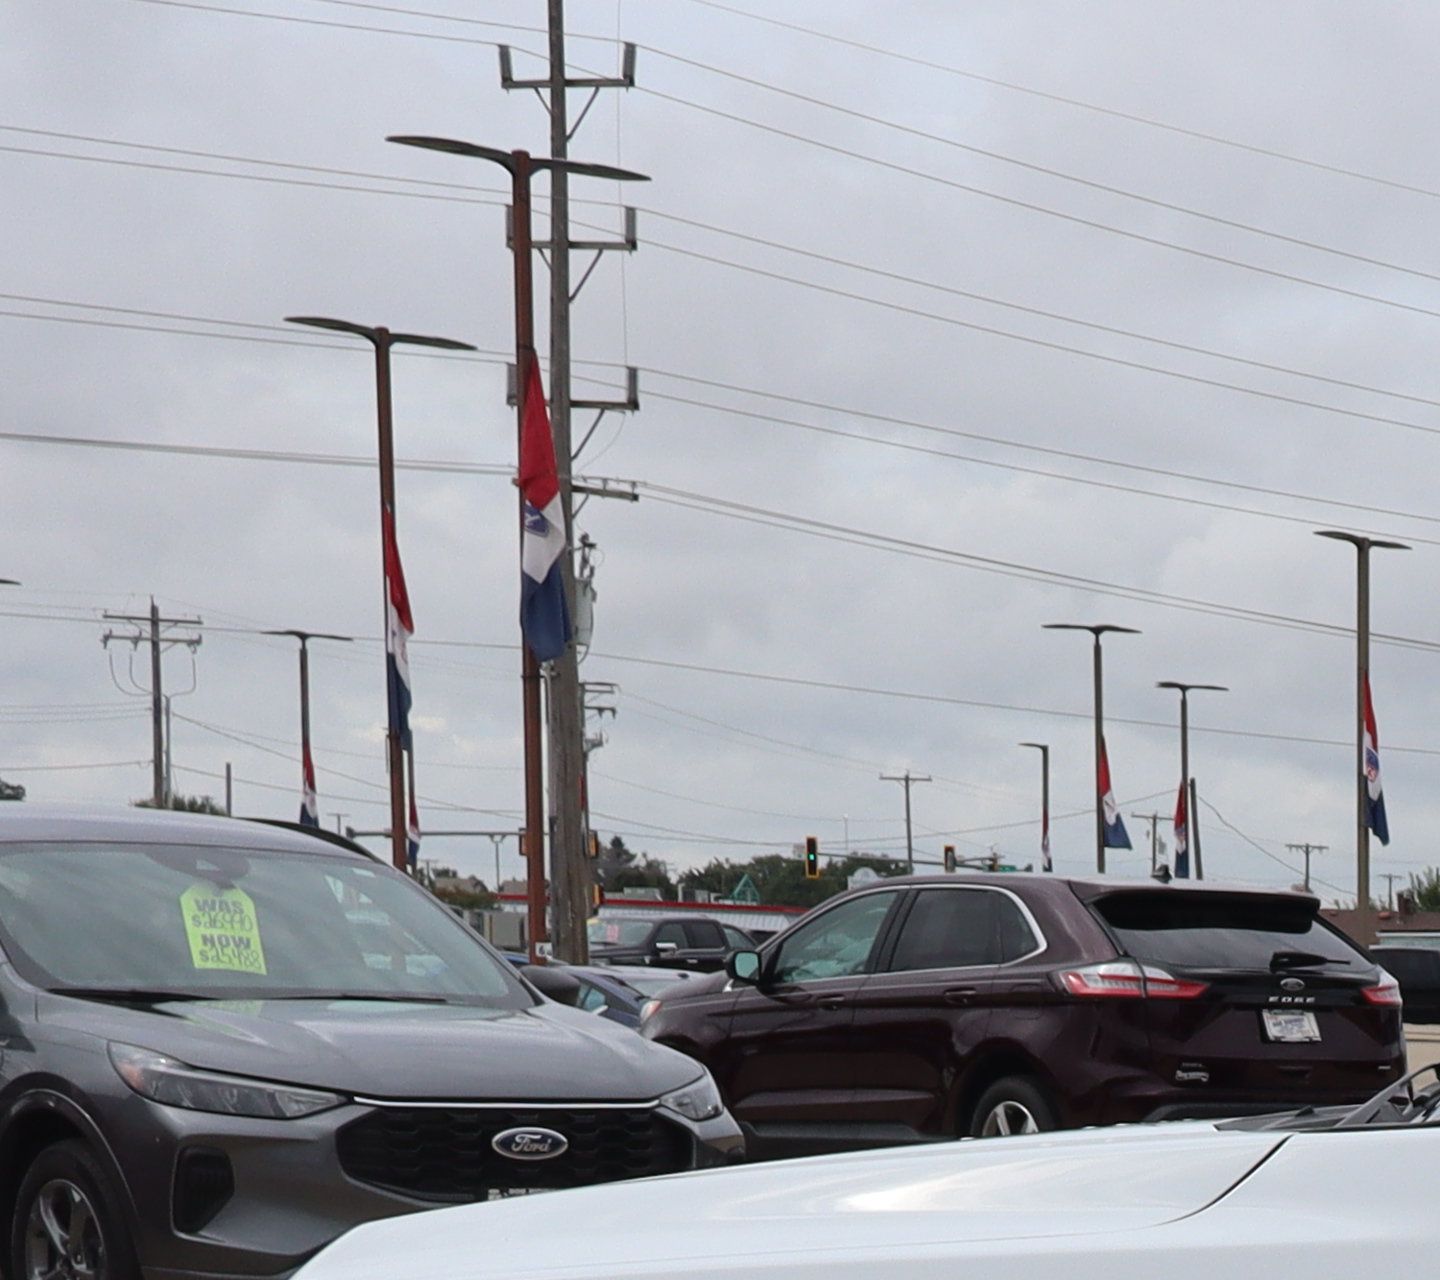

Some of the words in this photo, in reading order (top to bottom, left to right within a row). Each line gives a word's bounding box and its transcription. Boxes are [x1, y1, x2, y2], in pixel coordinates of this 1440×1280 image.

[193, 898, 244, 914] WAS
[201, 933, 251, 949] NOW
[511, 1133, 553, 1153] Ford
